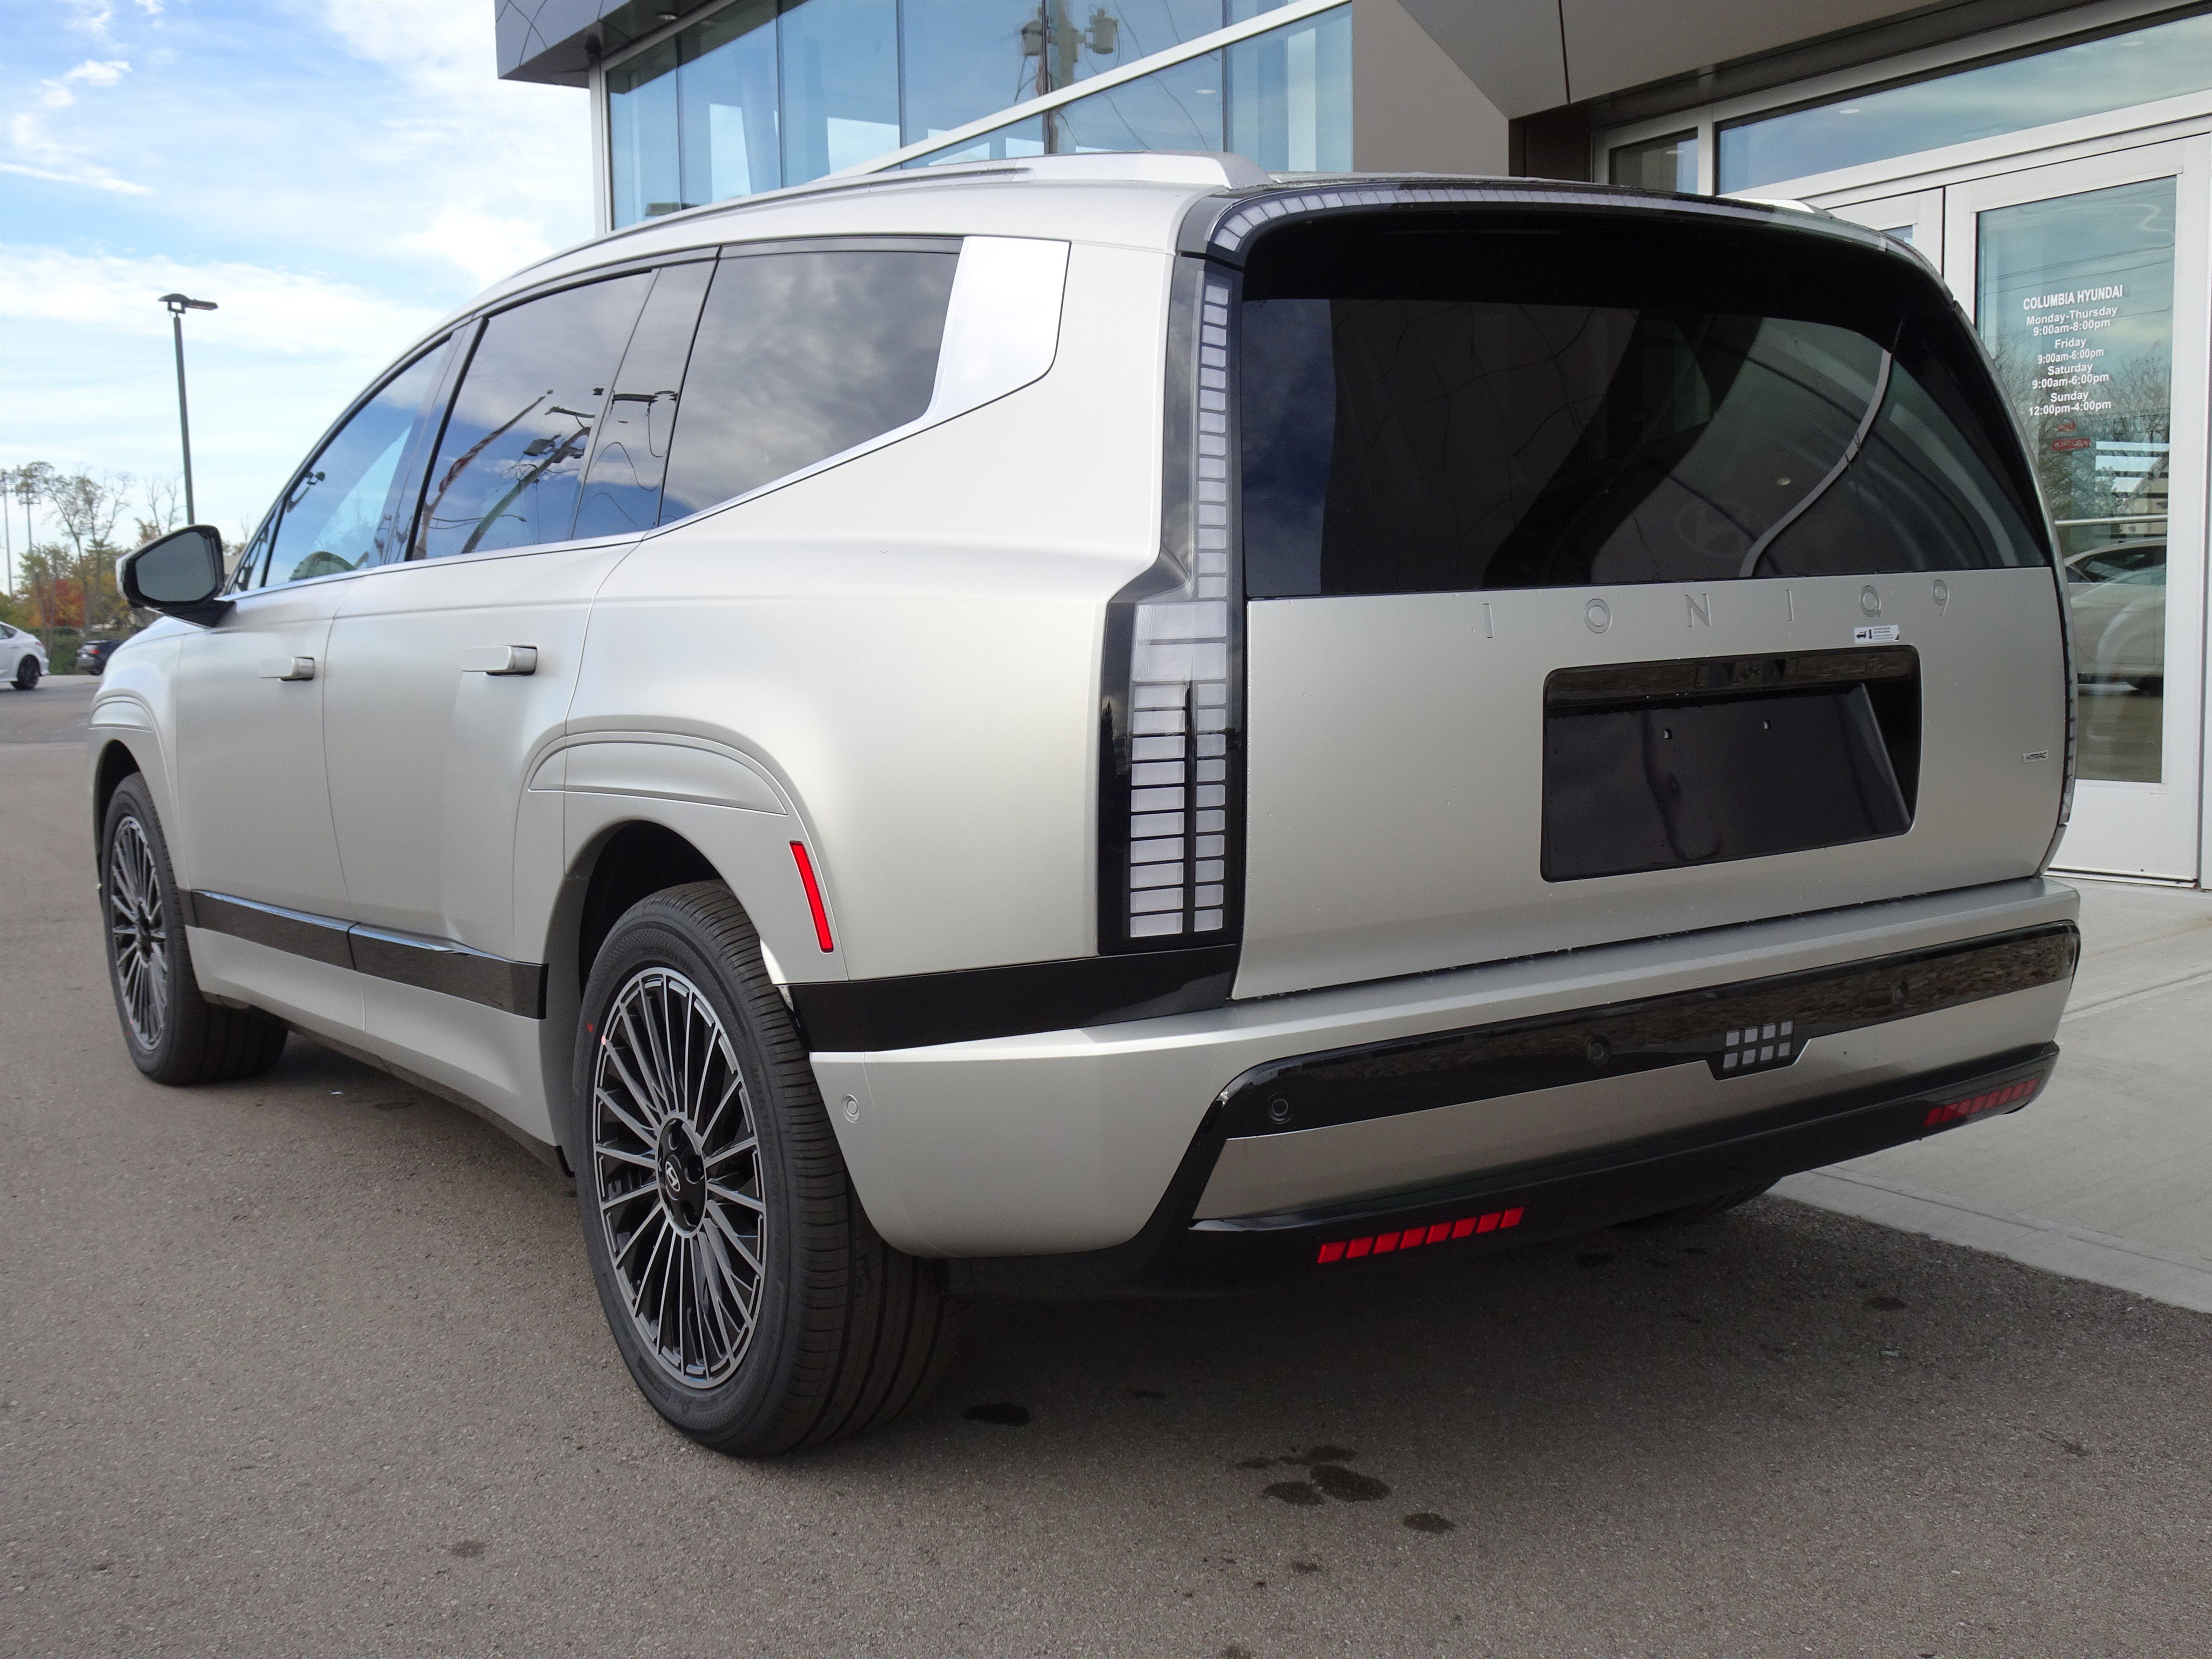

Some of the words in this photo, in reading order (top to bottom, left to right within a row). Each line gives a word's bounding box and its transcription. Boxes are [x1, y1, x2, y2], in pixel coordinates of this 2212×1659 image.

[2023, 292, 2075, 310] COLUMBIA
[2077, 285, 2123, 302] HYUNDAI
[2026, 306, 2118, 326] Monday-Thursday
[2033, 319, 2110, 336] 9:00am-8:00pm
[2054, 338, 2087, 349] Friday
[2037, 348, 2104, 364] 9:00am-6:00pm
[2047, 363, 2093, 376] Saturday
[2032, 374, 2109, 389] 9:00am-6:00pm
[2050, 391, 2089, 403] Sunday
[2028, 401, 2112, 416] 12:00pm-4:00pm
[1483, 585, 1882, 638] IONIQ
[1932, 579, 1950, 616] 9
[2025, 752, 2047, 761] HTRAC
